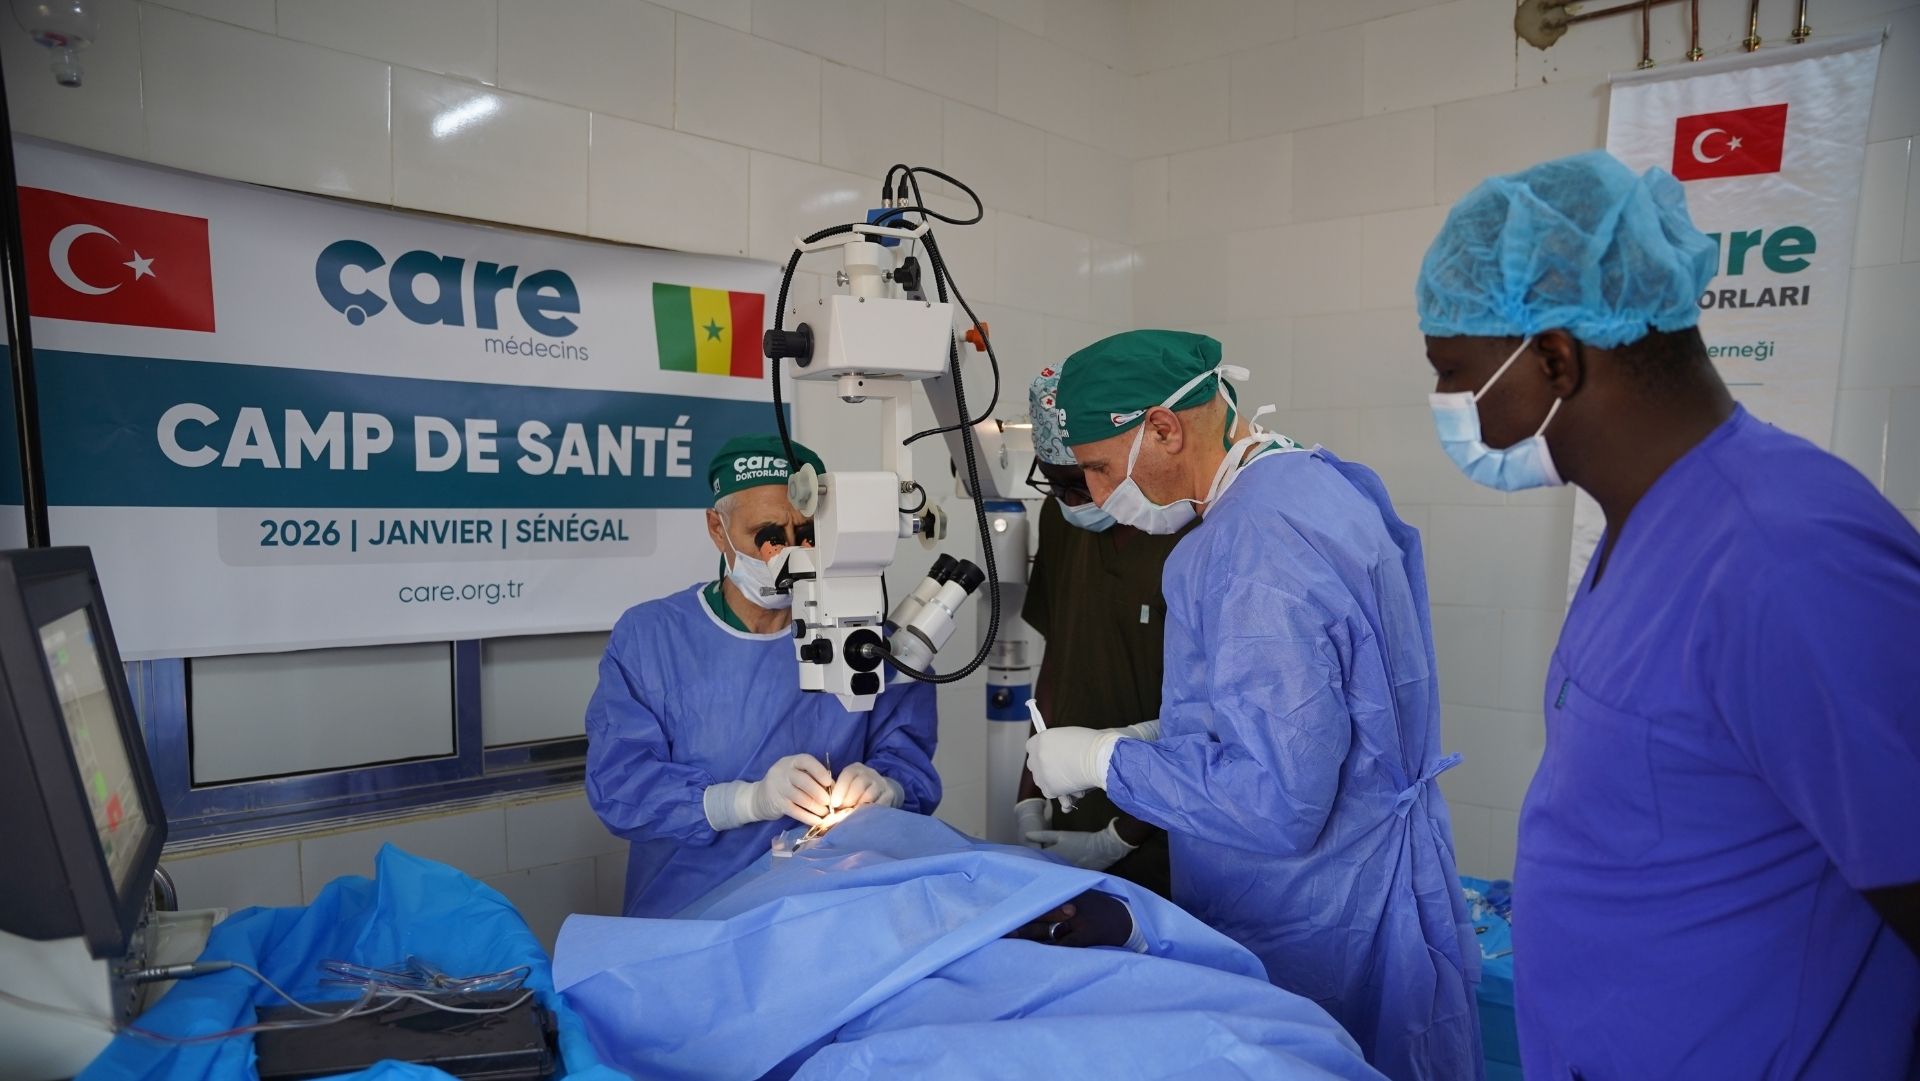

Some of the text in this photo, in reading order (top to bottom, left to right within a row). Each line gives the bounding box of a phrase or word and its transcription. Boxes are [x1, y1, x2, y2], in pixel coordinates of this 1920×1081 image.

[1706, 226, 1816, 275] re
[316, 239, 580, 337] çare
[1697, 285, 1810, 309] ORLARI
[485, 335, 589, 361] médecins
[1707, 341, 1774, 361] erneği
[157, 403, 692, 477] CAMP DE SANTÉ
[736, 470, 788, 481] DOKTORLARI
[260, 520, 341, 546] 2026
[368, 520, 493, 545] JANVIER
[516, 513, 629, 543] SÉNÉGAL
[399, 579, 524, 605] care.org.tr
